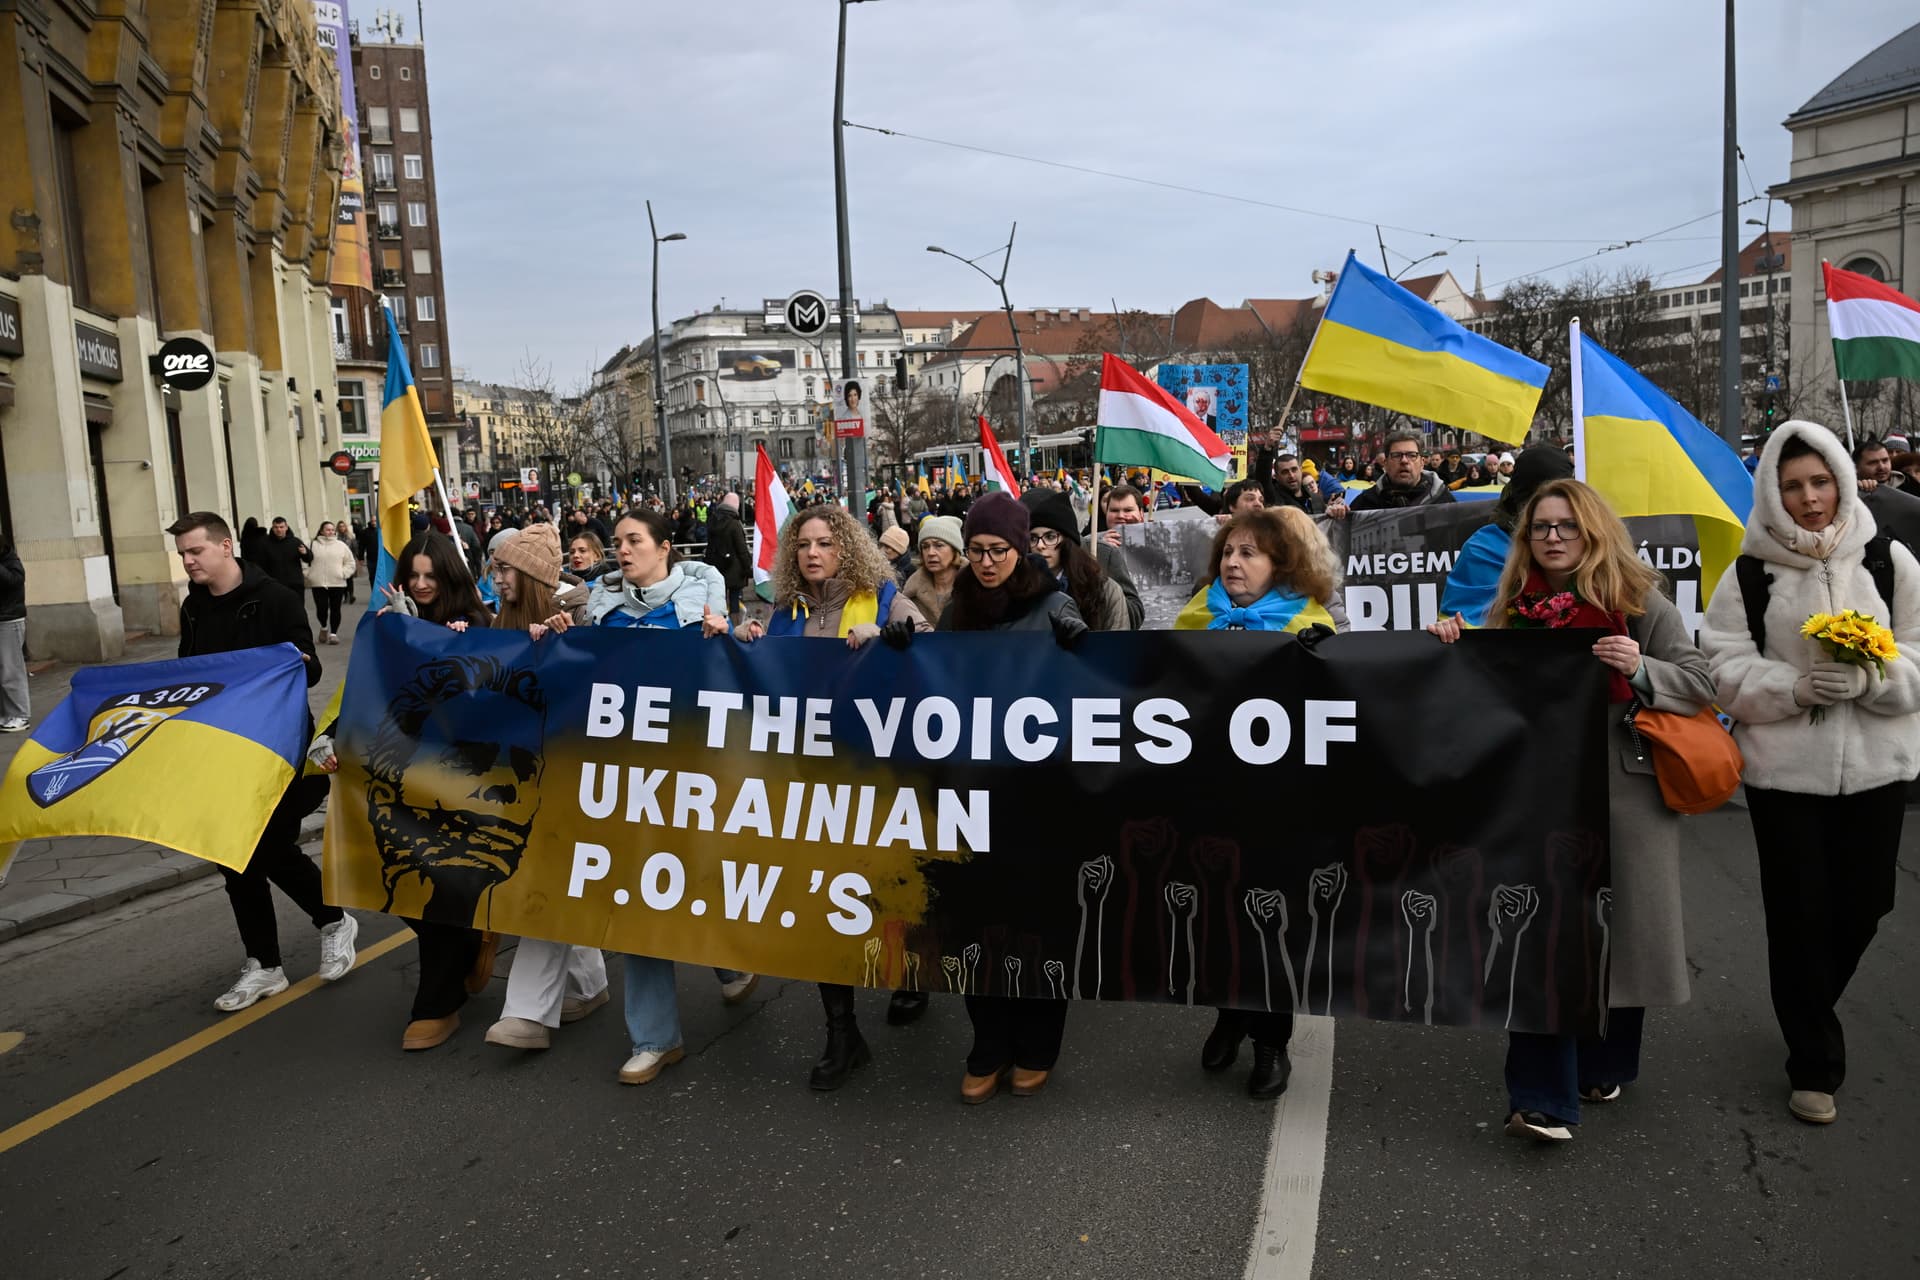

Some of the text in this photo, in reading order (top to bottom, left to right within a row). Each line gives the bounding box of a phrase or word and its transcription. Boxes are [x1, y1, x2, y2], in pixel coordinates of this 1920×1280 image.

[163, 353, 209, 370] one
[586, 682, 1358, 767] BE THE VOICES OF
[578, 761, 991, 853] UKRAINIAN
[567, 841, 874, 937] P.O.W.'S
